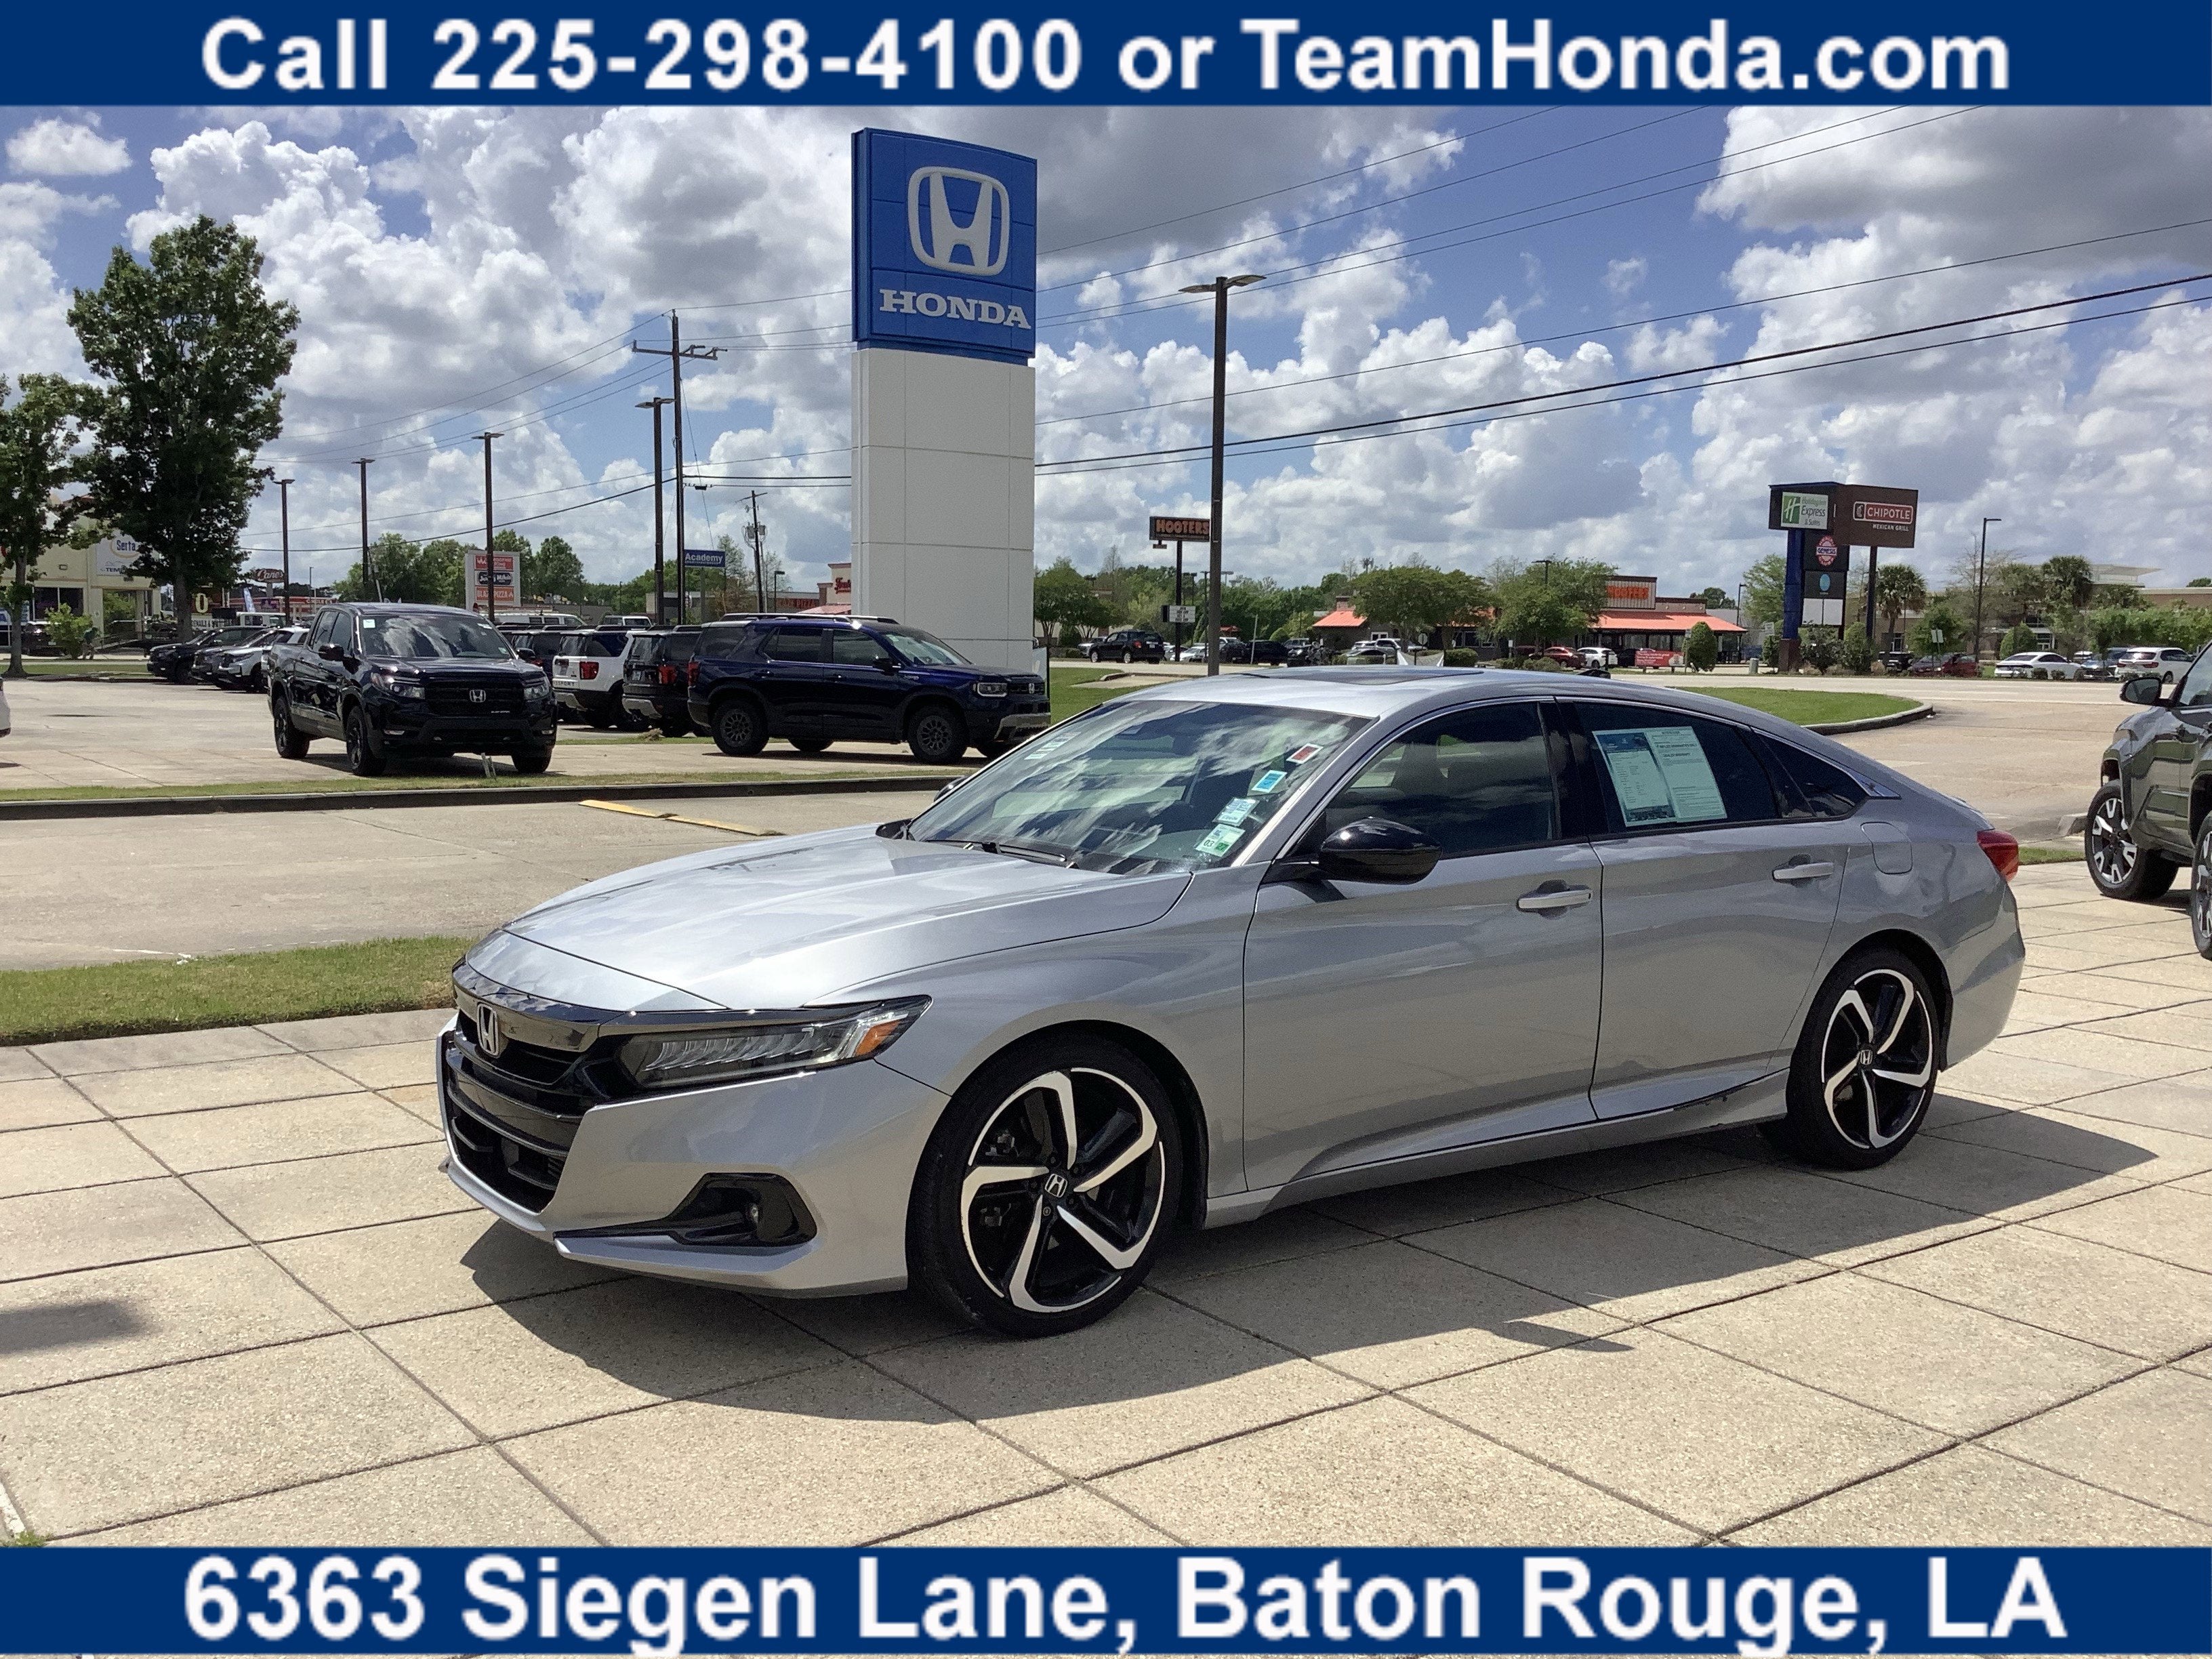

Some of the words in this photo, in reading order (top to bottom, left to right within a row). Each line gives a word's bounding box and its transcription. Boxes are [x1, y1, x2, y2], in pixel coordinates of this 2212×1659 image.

[880, 289, 1032, 329] HONDA
[1801, 506, 1826, 518] Express
[1867, 508, 1910, 520] CHIPOTLE
[1156, 519, 1209, 535] HOOTERS
[117, 539, 136, 550] Serta
[684, 552, 723, 564] Academy
